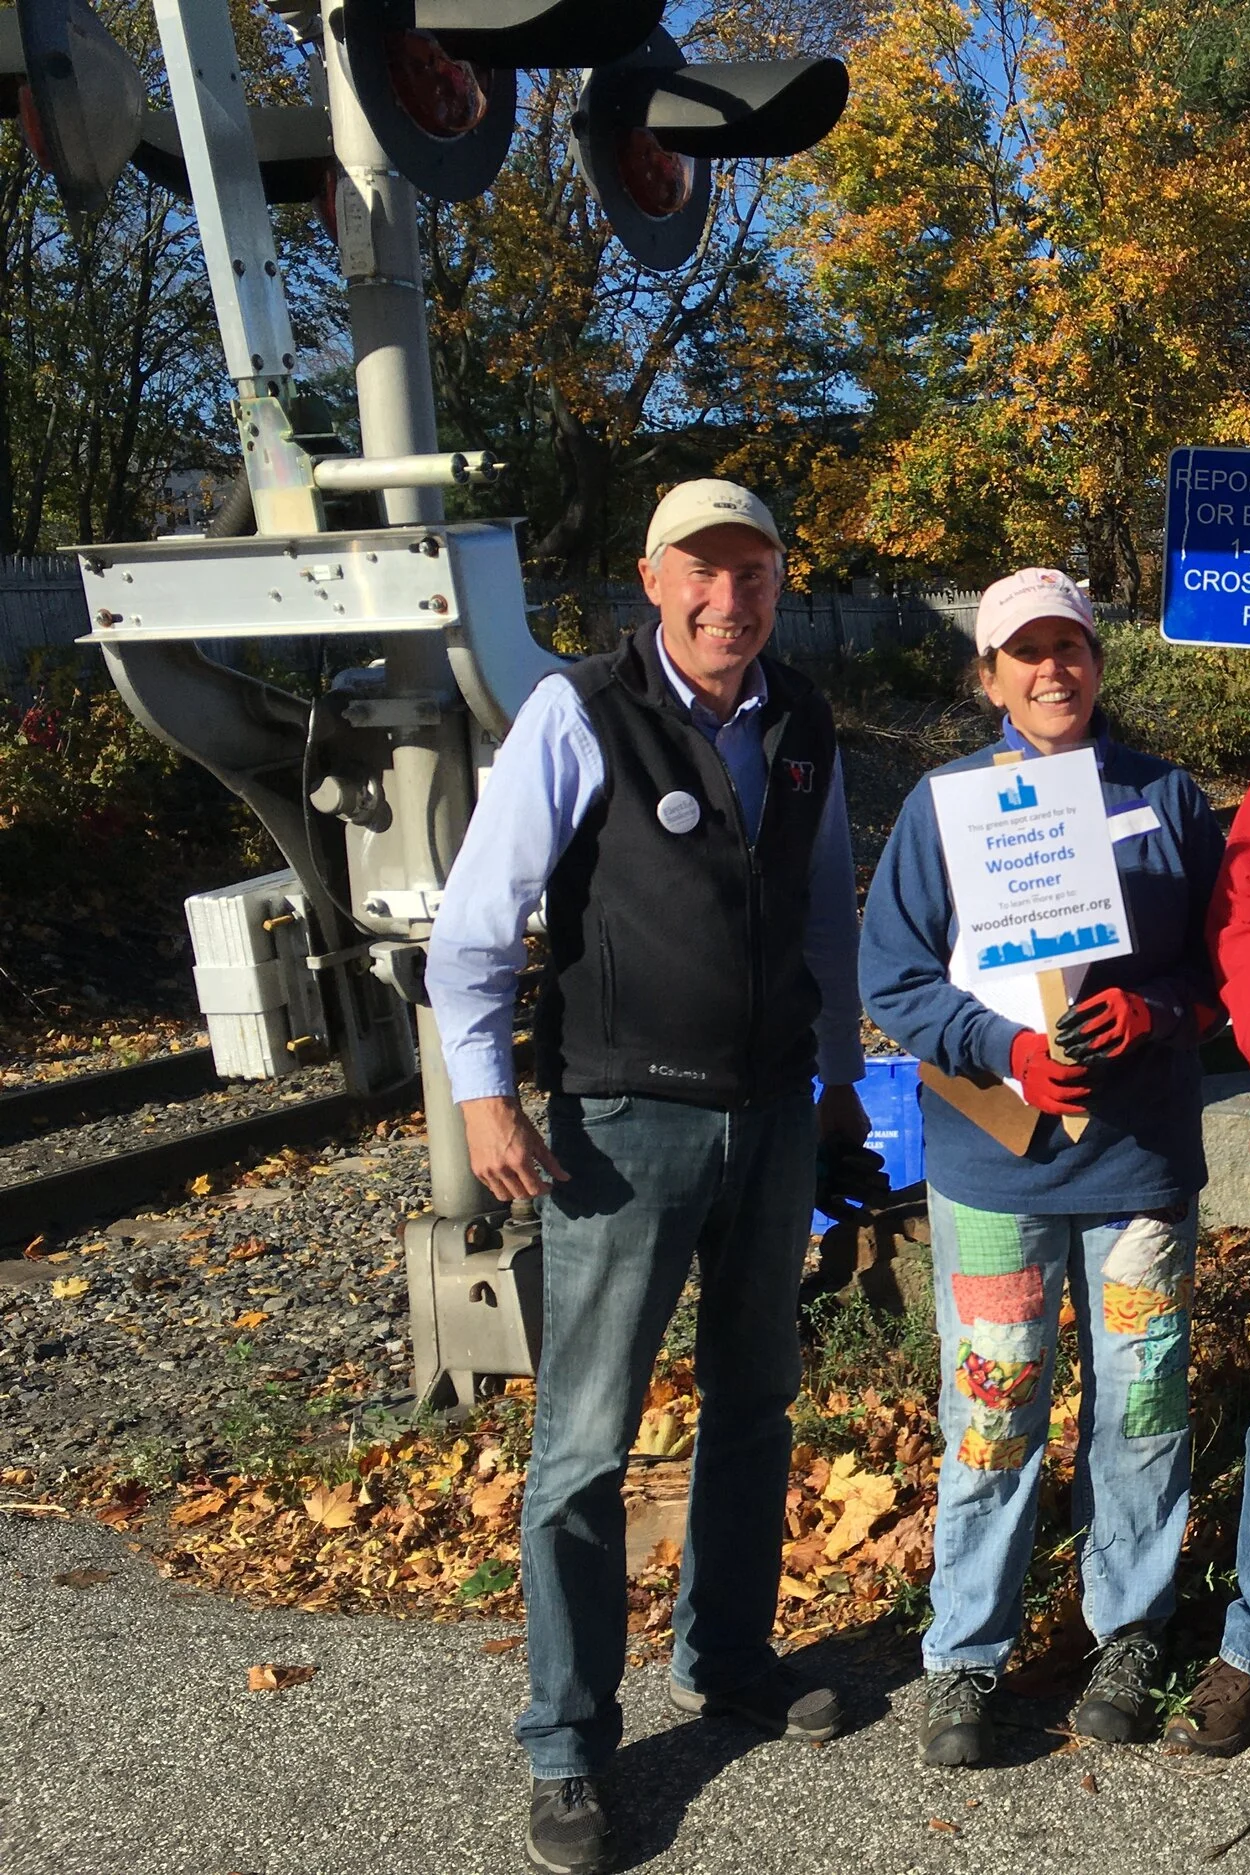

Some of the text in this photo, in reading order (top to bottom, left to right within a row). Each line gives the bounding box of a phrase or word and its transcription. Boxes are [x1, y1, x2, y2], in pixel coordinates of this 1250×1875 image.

[1197, 503, 1234, 525] OR
[967, 806, 1076, 832] This green spot cared for by
[986, 822, 1065, 850] Friends of
[985, 846, 1075, 874] Woodfords
[1008, 874, 1062, 893] Corner
[998, 902, 1009, 910] To
[1010, 898, 1031, 908] learn
[1032, 895, 1053, 903] more
[1055, 892, 1066, 900] go
[971, 898, 1112, 933] woodfordscorner.org
[874, 1130, 899, 1138] MAINE
